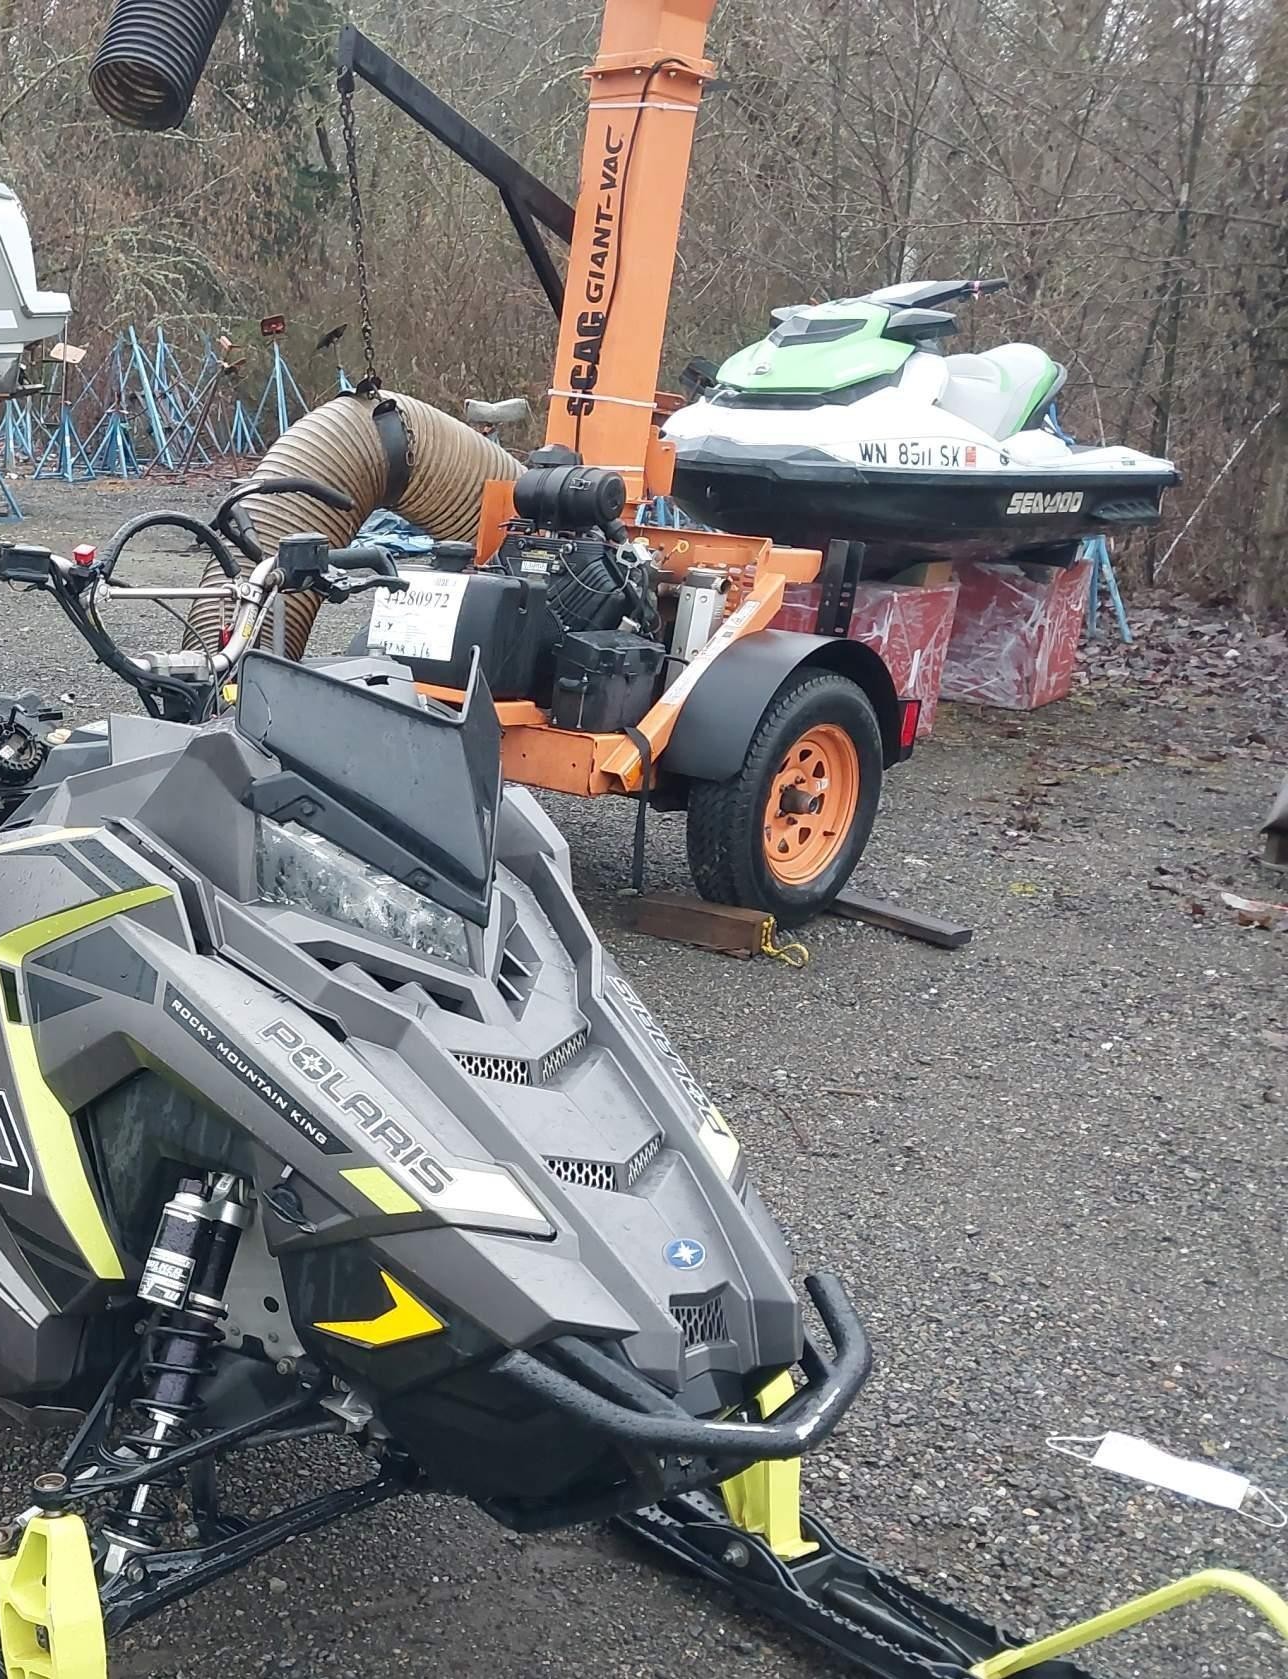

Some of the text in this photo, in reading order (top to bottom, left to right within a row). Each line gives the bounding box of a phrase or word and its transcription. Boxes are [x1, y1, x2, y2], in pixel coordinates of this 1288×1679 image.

[566, 124, 624, 417] SCAG GIANT-VAC
[859, 442, 887, 464] WN
[940, 444, 961, 467] SK
[170, 999, 329, 1146] ROCKY MOUNTAIN KING
[259, 1018, 458, 1197] POLARIS
